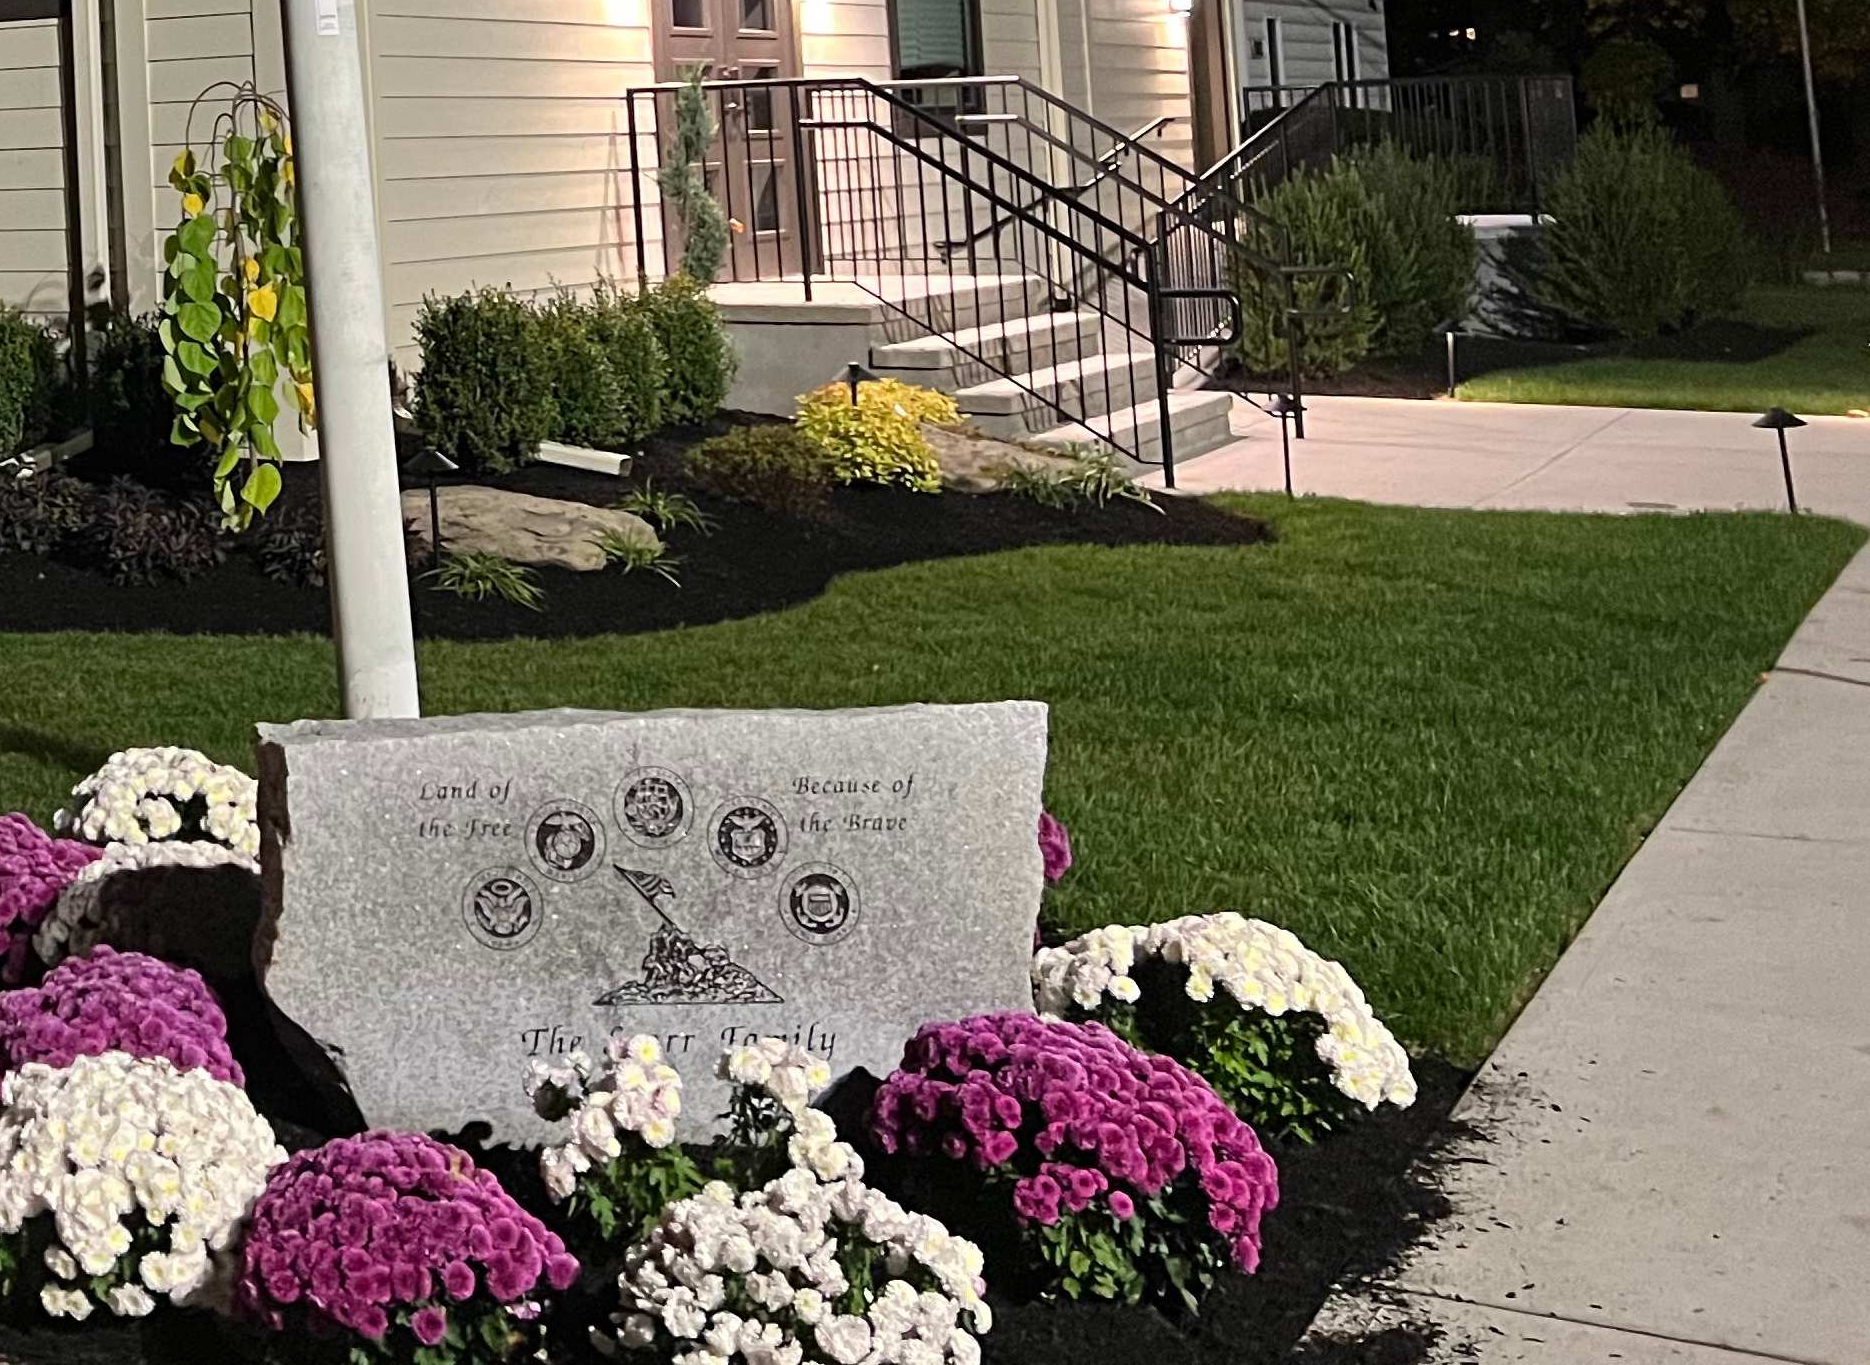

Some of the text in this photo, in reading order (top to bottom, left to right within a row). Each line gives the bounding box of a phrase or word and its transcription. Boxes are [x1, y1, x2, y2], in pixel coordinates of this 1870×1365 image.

[419, 776, 513, 805] Land of
[792, 772, 917, 800] Because of
[419, 817, 512, 840] the Free
[800, 812, 907, 833] the Brave
[521, 1024, 582, 1057] The
[721, 1021, 836, 1062] Faily
